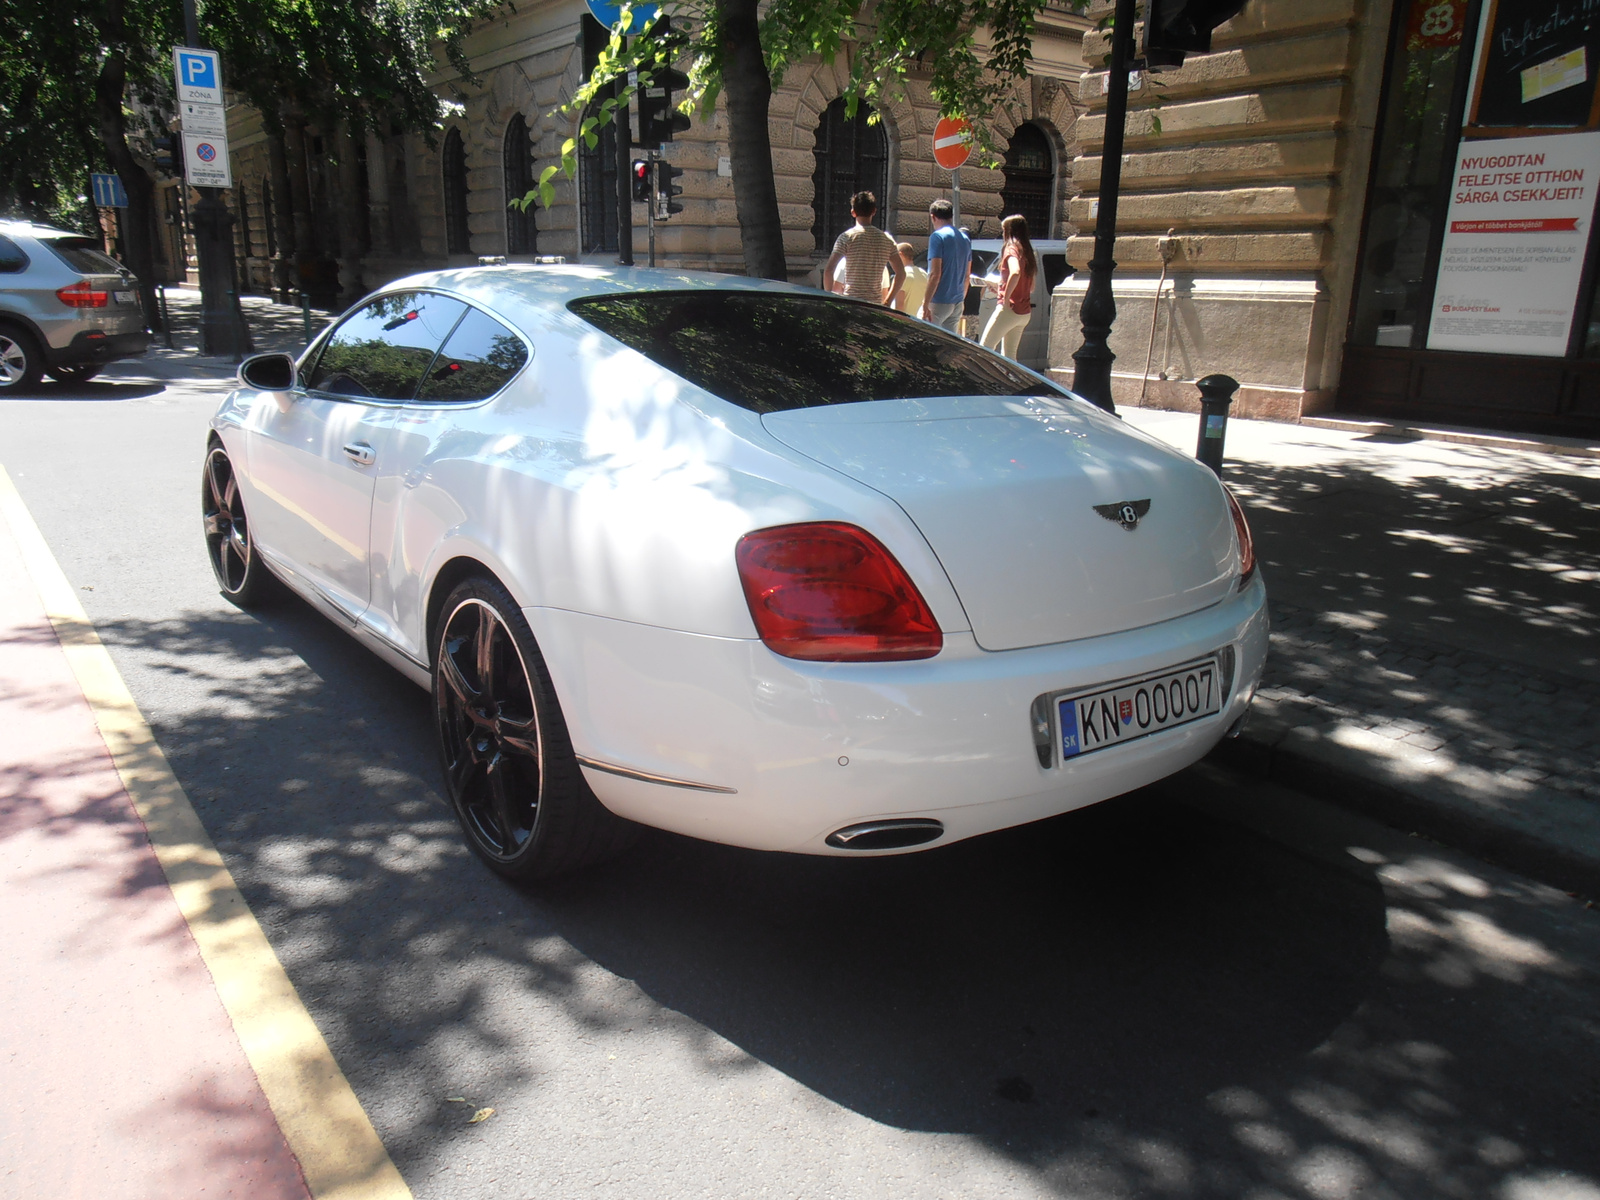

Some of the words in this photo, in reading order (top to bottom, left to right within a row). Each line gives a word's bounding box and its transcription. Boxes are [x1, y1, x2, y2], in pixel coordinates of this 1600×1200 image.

[187, 58, 207, 82] P
[1461, 153, 1545, 170] NYUGODTAN
[1458, 172, 1522, 187] FELEJTSE
[1525, 169, 1584, 184] OTTHON
[1455, 188, 1499, 204] SÁRGA
[1503, 187, 1584, 202] CSEKKJEIT!
[1456, 222, 1477, 231] Várjon
[1080, 695, 1120, 746] KN
[1064, 735, 1077, 748] SK
